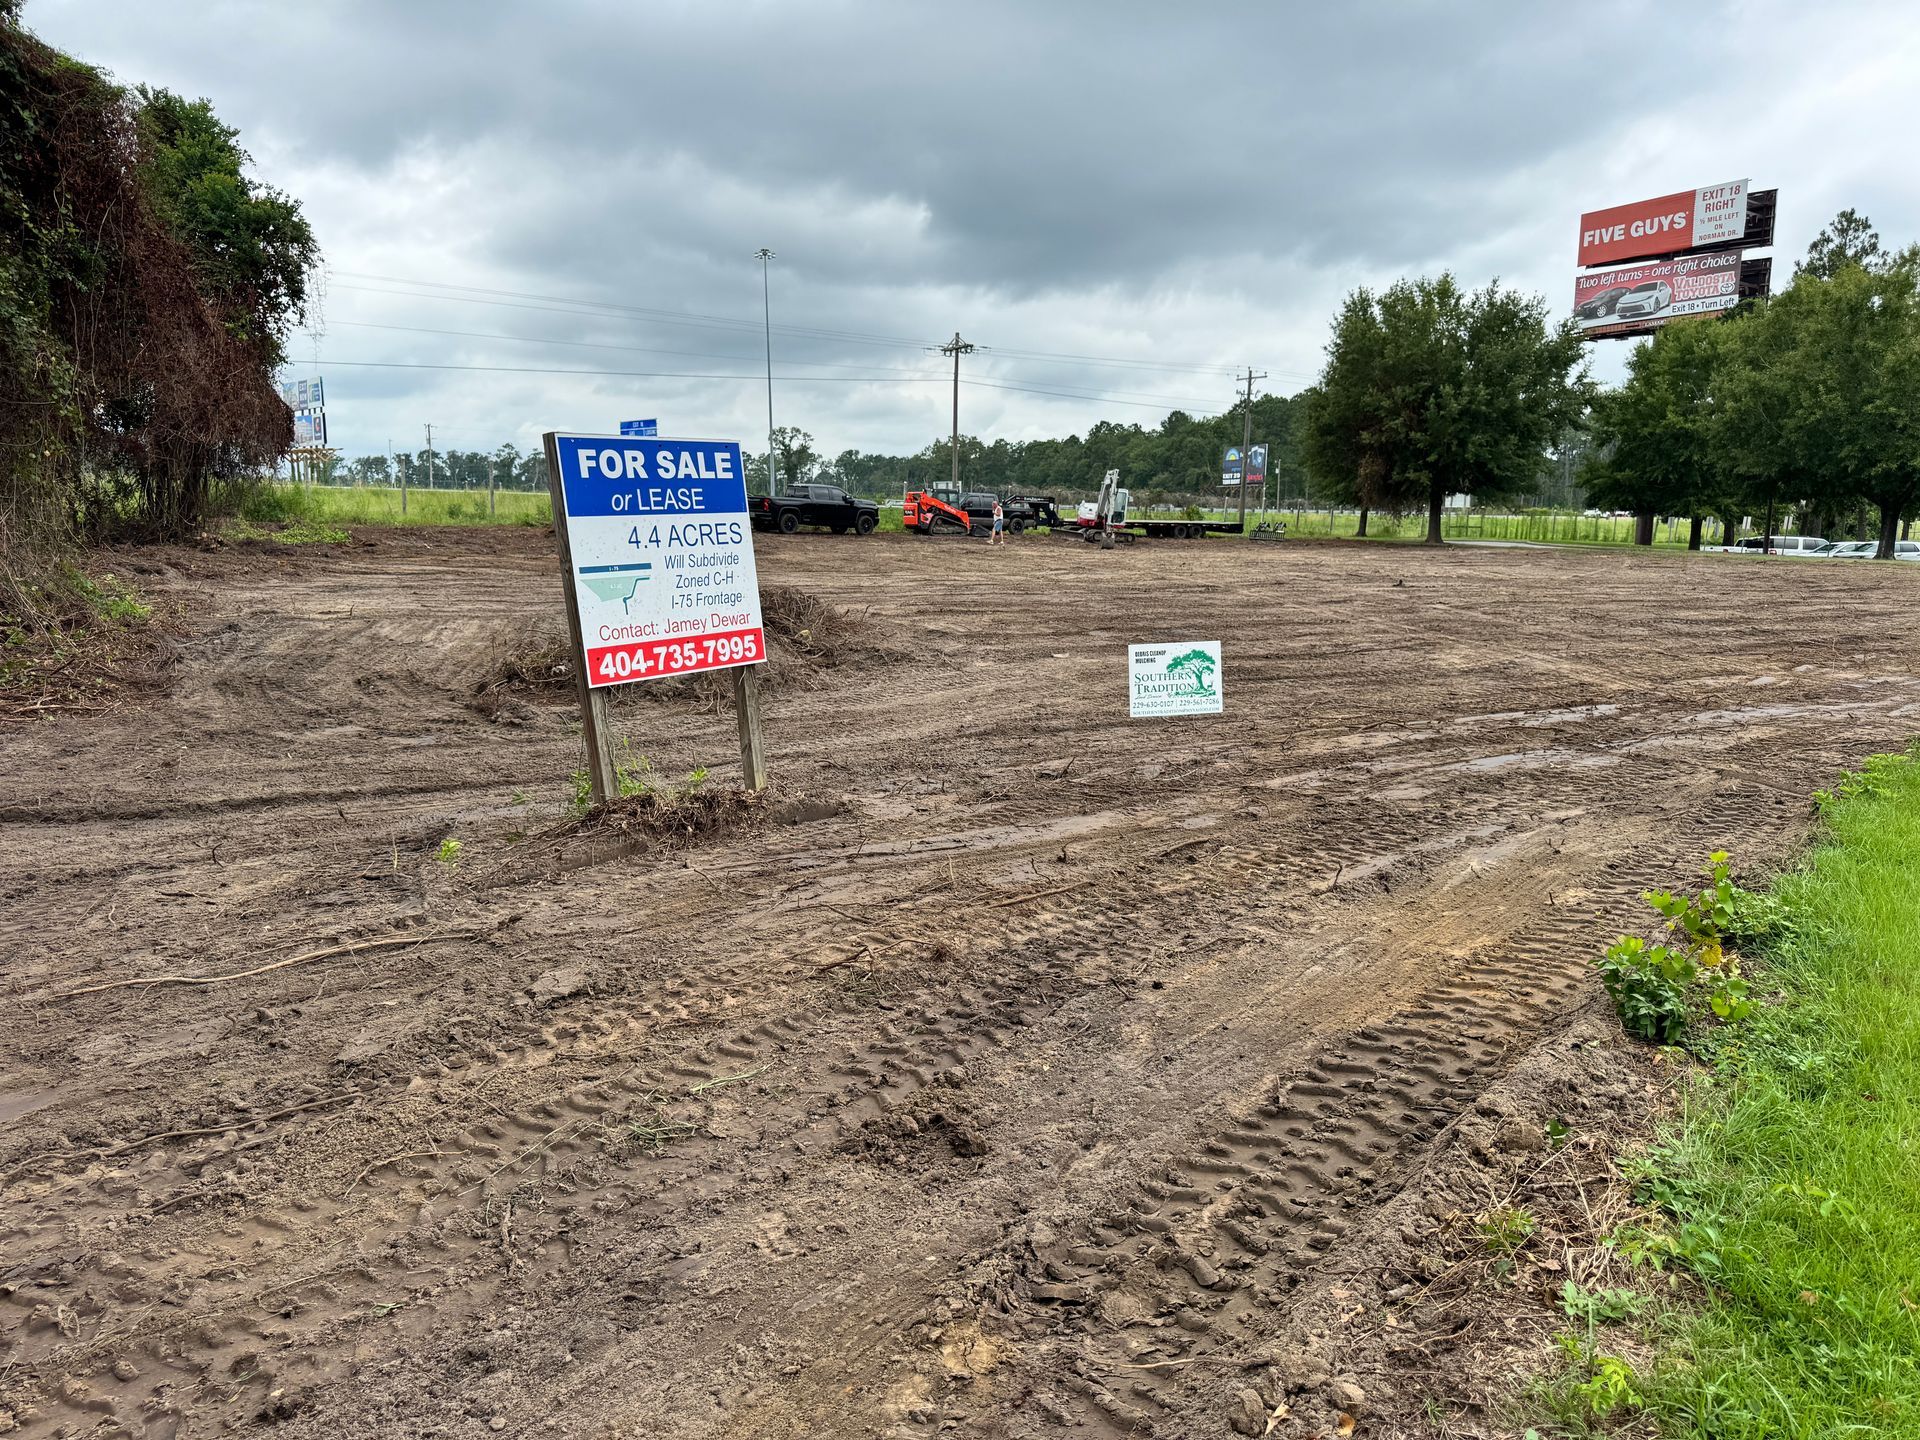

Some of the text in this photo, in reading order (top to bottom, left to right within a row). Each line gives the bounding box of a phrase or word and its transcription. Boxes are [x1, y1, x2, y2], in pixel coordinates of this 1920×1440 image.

[1702, 184, 1741, 201] EXIT 18
[1704, 198, 1735, 213] RIGHT
[1707, 214, 1722, 223] MILE
[1724, 212, 1739, 220] LEFT
[1583, 212, 1687, 247] FIVE GUYS
[1698, 231, 1725, 241] NORMAN
[1579, 278, 1598, 289] Two
[1600, 273, 1615, 286] left
[1617, 270, 1642, 282] turns
[1651, 266, 1671, 277] one
[1672, 260, 1698, 275] right
[1700, 254, 1737, 269] choice
[1673, 271, 1736, 290] VALDOSTA
[1675, 285, 1721, 301] TOYOTA
[1672, 297, 1735, 313] Exit 18 Turn Left
[577, 448, 734, 479] FOR SALE
[611, 488, 705, 511] or LEASE
[628, 522, 743, 549] 4.4 ACRES
[664, 552, 739, 569] Will Subdivide
[675, 570, 734, 589] Zoned C-H
[671, 591, 742, 609] I-75 Frontage
[599, 613, 751, 641] Contact: Jamey Dewar
[599, 634, 757, 678] 404-735-7995
[1134, 672, 1192, 684] SOUTHERN
[1134, 683, 1195, 695] TRADITION
[1132, 701, 1174, 709] 229-630-0107
